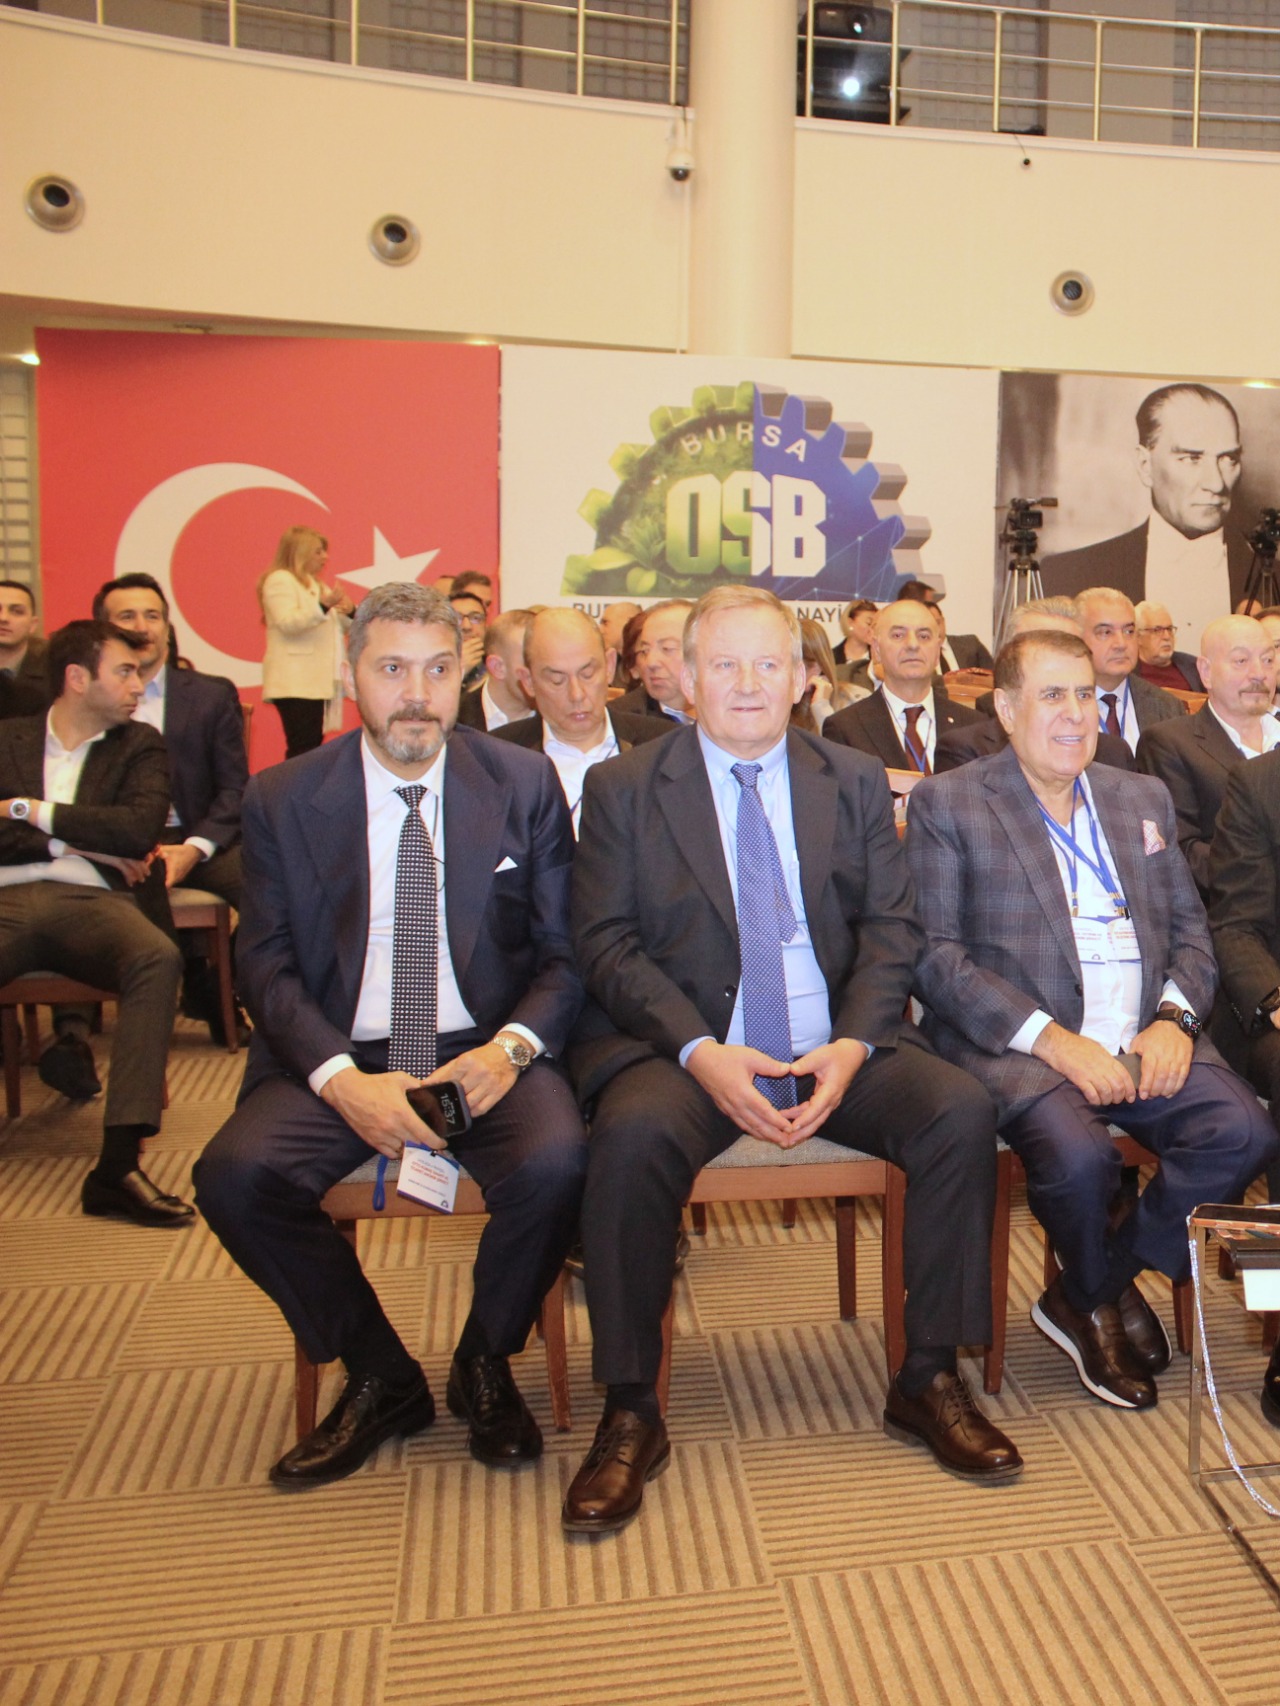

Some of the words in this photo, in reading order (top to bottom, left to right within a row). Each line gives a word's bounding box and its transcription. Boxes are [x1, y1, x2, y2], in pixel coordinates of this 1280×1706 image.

[681, 421, 807, 462] BURSA
[666, 471, 826, 577] OSB
[797, 604, 842, 622] NAYİ
